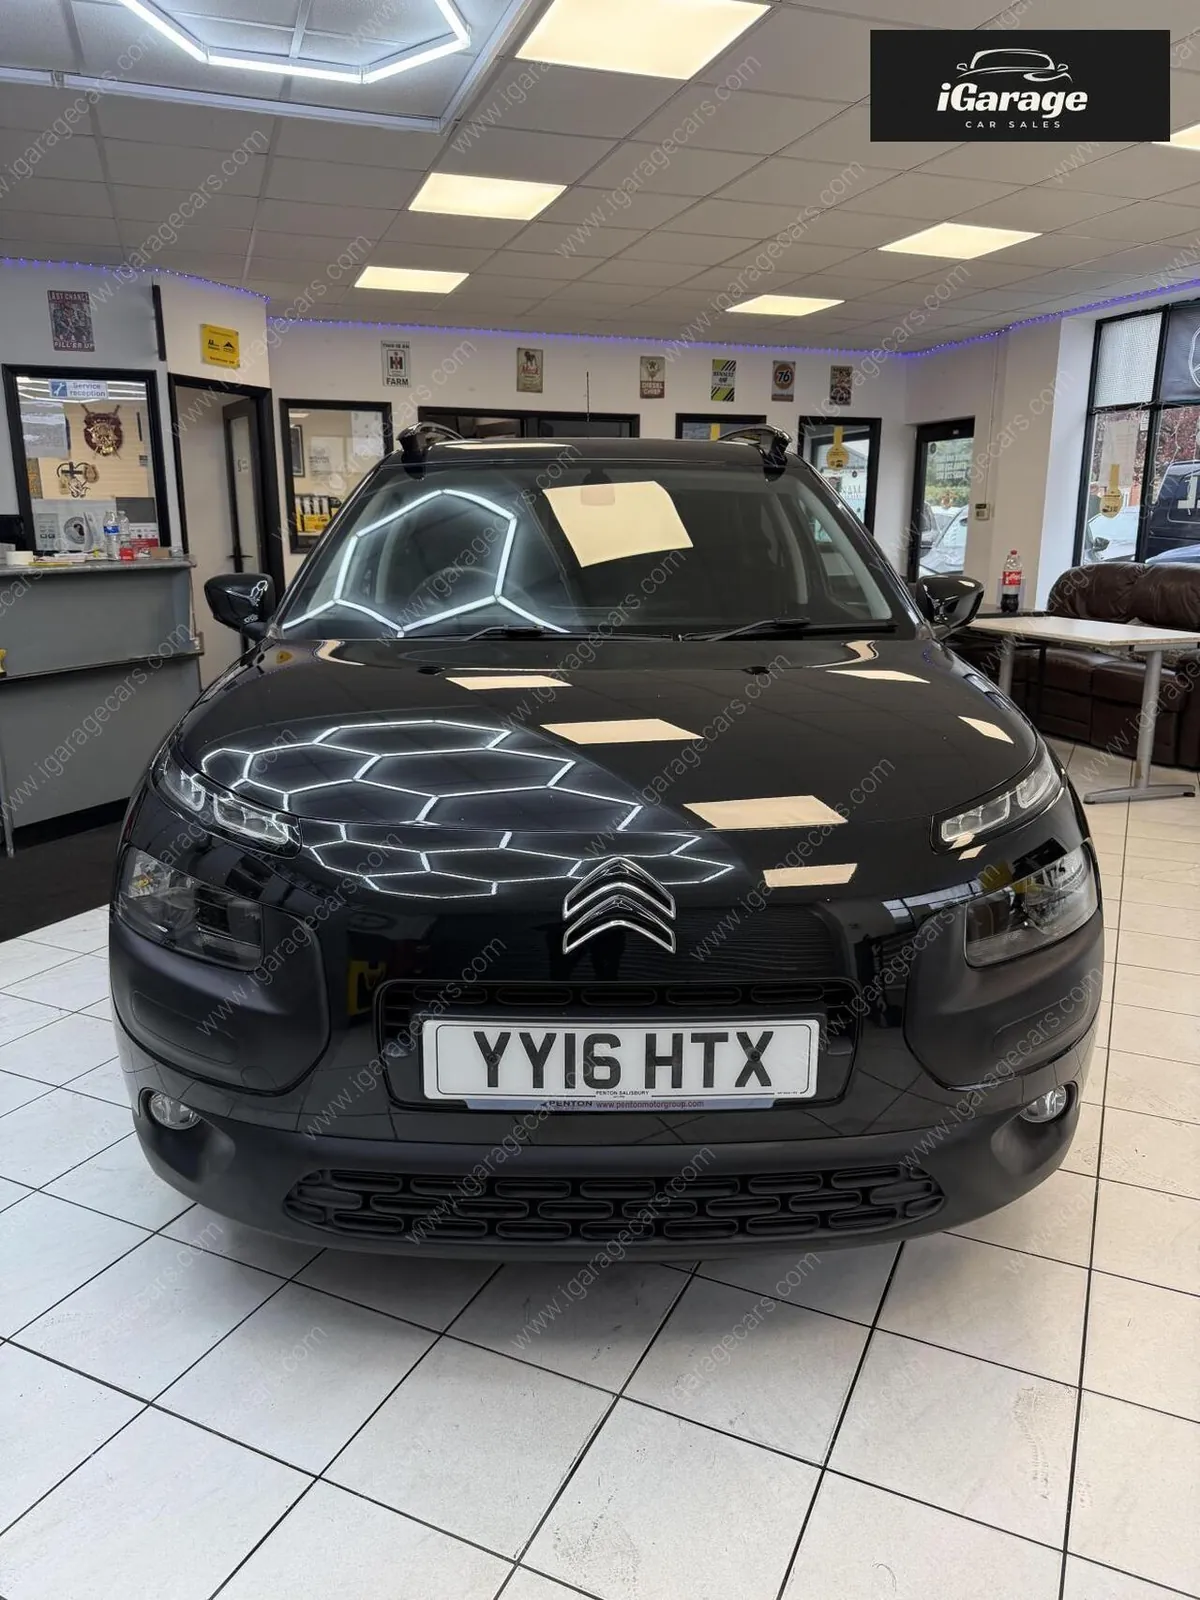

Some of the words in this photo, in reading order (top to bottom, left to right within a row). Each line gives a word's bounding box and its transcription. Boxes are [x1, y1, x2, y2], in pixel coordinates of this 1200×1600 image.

[777, 370, 790, 382] 76
[73, 382, 101, 390] Service
[387, 377, 409, 386] FARM
[69, 389, 106, 398] reception
[473, 1031, 621, 1089] YY16
[645, 1031, 774, 1089] HTX
[596, 1101, 705, 1109] www.pentonmotorgroup.com
